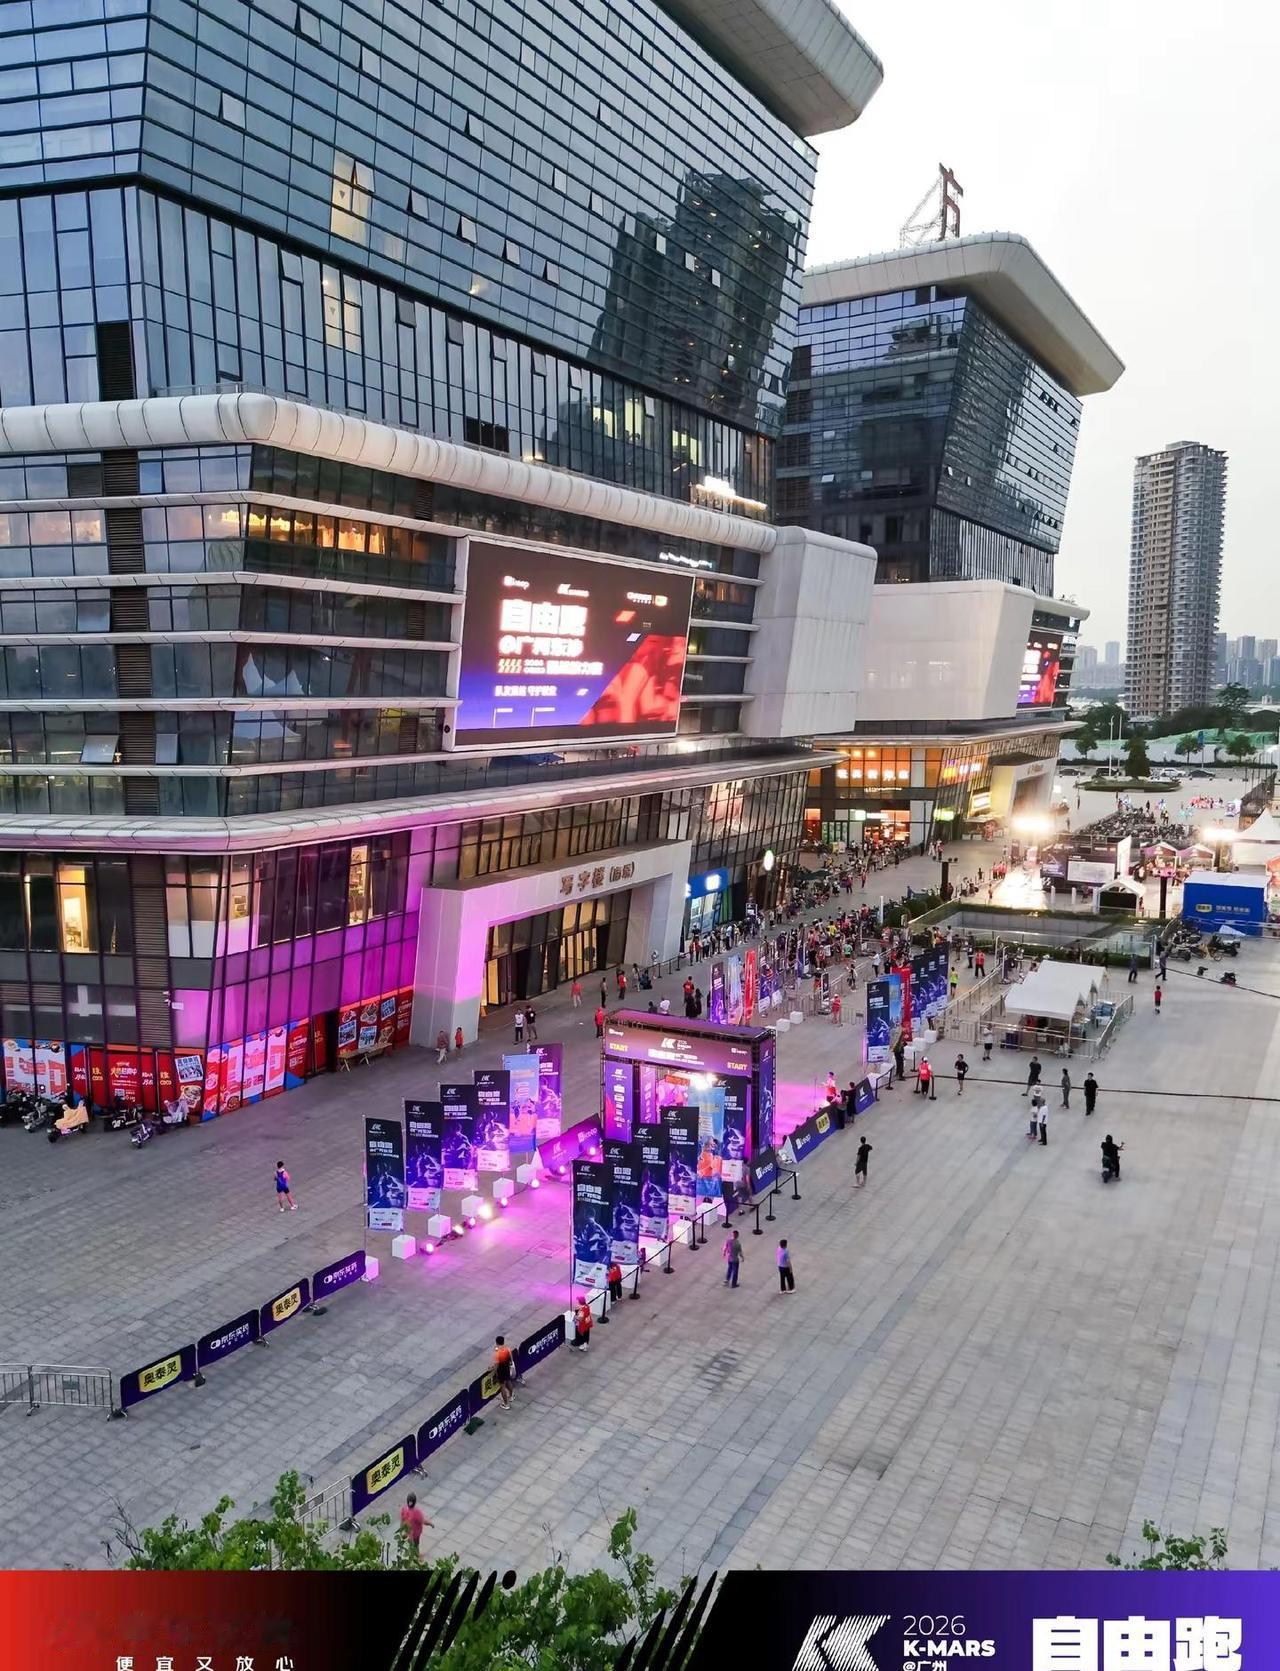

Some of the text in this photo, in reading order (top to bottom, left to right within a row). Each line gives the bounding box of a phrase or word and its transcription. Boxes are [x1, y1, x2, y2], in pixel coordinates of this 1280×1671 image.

[609, 1042, 629, 1053] START
[726, 1061, 748, 1071] START
[275, 1293, 299, 1315] 奥泰灵
[143, 1360, 178, 1387] 奥泰灵
[370, 1455, 401, 1487] 奥泰灵
